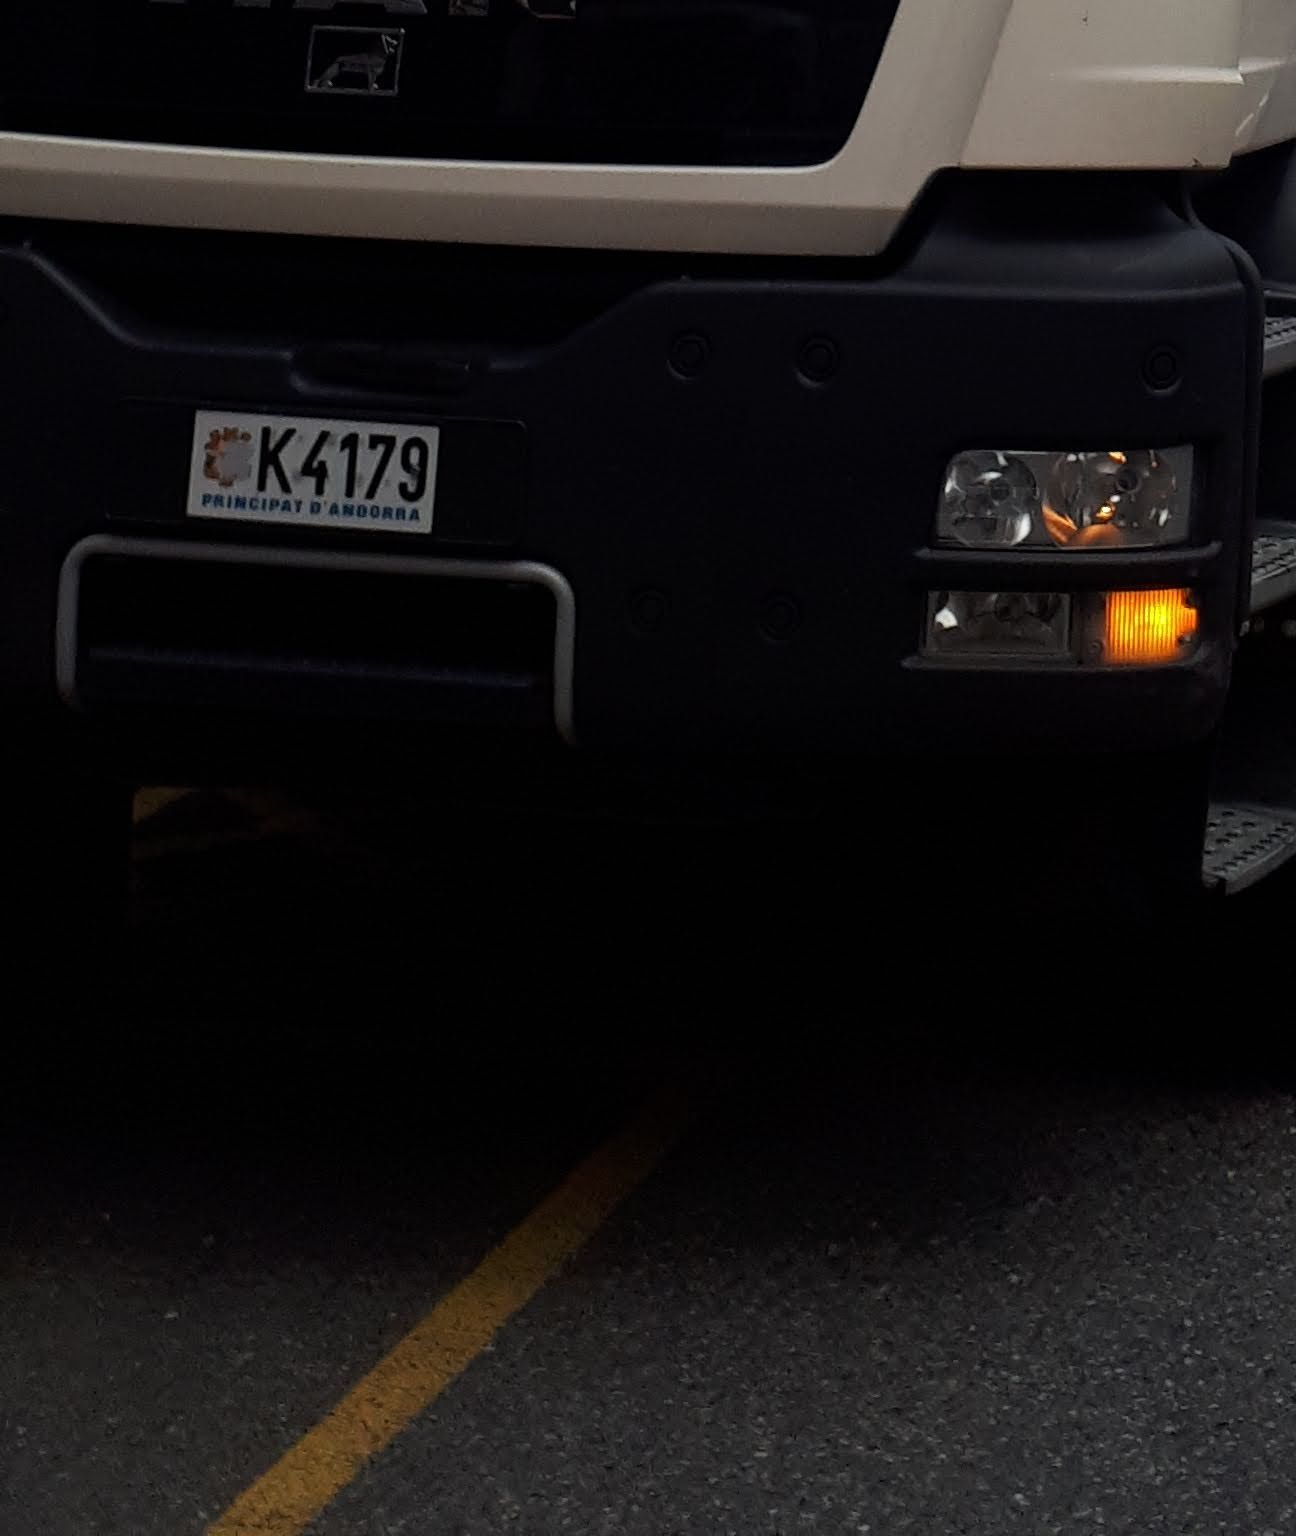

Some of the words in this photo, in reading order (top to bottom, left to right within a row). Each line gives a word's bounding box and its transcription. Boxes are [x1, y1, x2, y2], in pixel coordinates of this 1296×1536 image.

[257, 426, 429, 503] K4179
[202, 493, 303, 514] PRINCIPAT
[308, 500, 421, 522] D'ANDORRA
